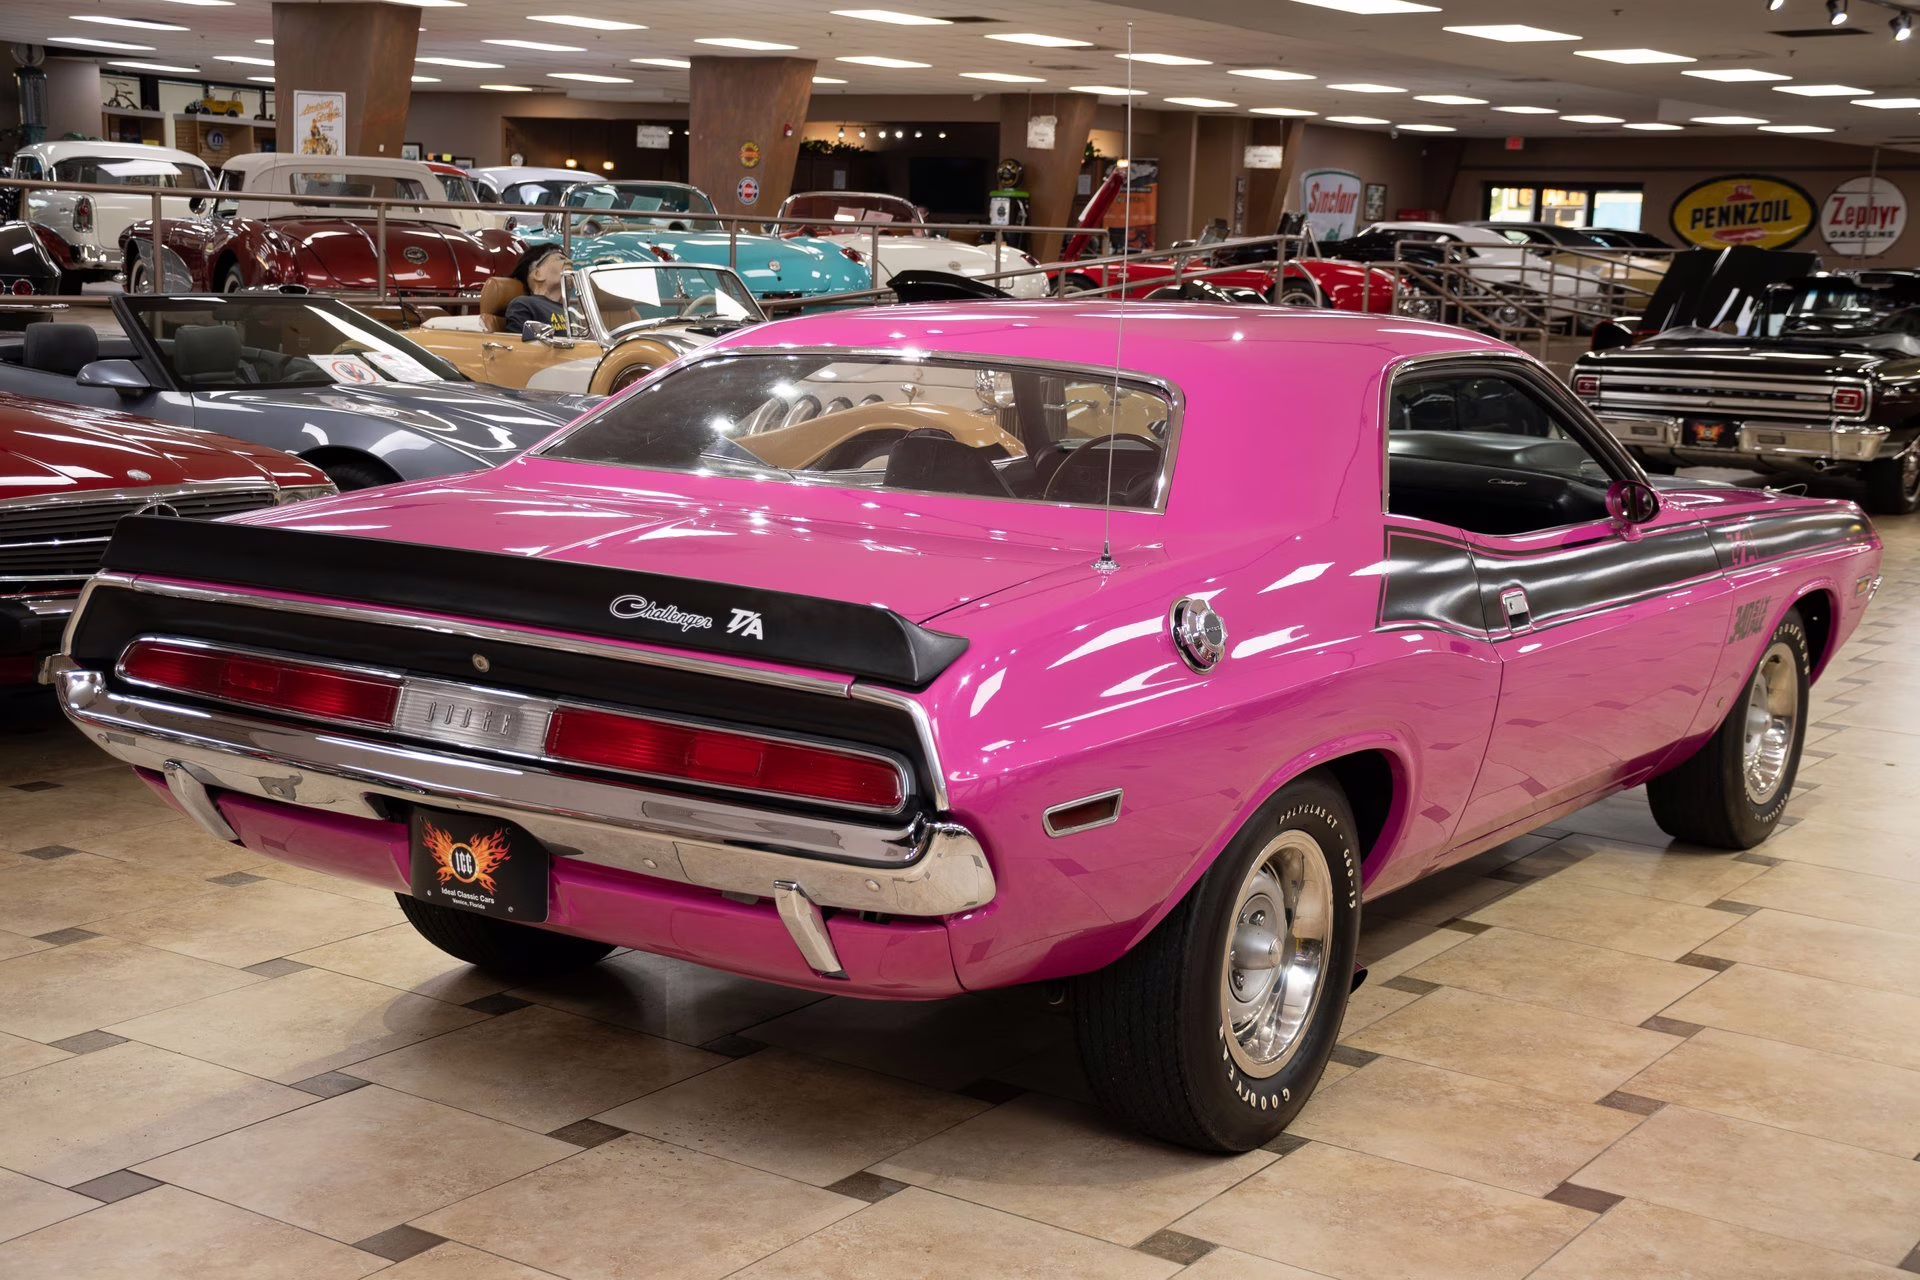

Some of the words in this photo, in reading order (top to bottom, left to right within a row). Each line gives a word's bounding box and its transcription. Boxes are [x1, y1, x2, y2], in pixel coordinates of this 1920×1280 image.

[1308, 182, 1358, 214] Sinclair
[1829, 196, 1901, 229] Zephyr
[1690, 199, 1793, 231] PENNZOIL
[1829, 230, 1896, 239] GASOLINE
[609, 594, 712, 632] Challenger
[726, 608, 764, 640] T/A
[424, 701, 511, 735] DODGE
[1279, 804, 1326, 825] POLYGLAS
[441, 887, 456, 897] Ideal
[457, 890, 479, 901] Classic
[480, 895, 495, 904] Cars
